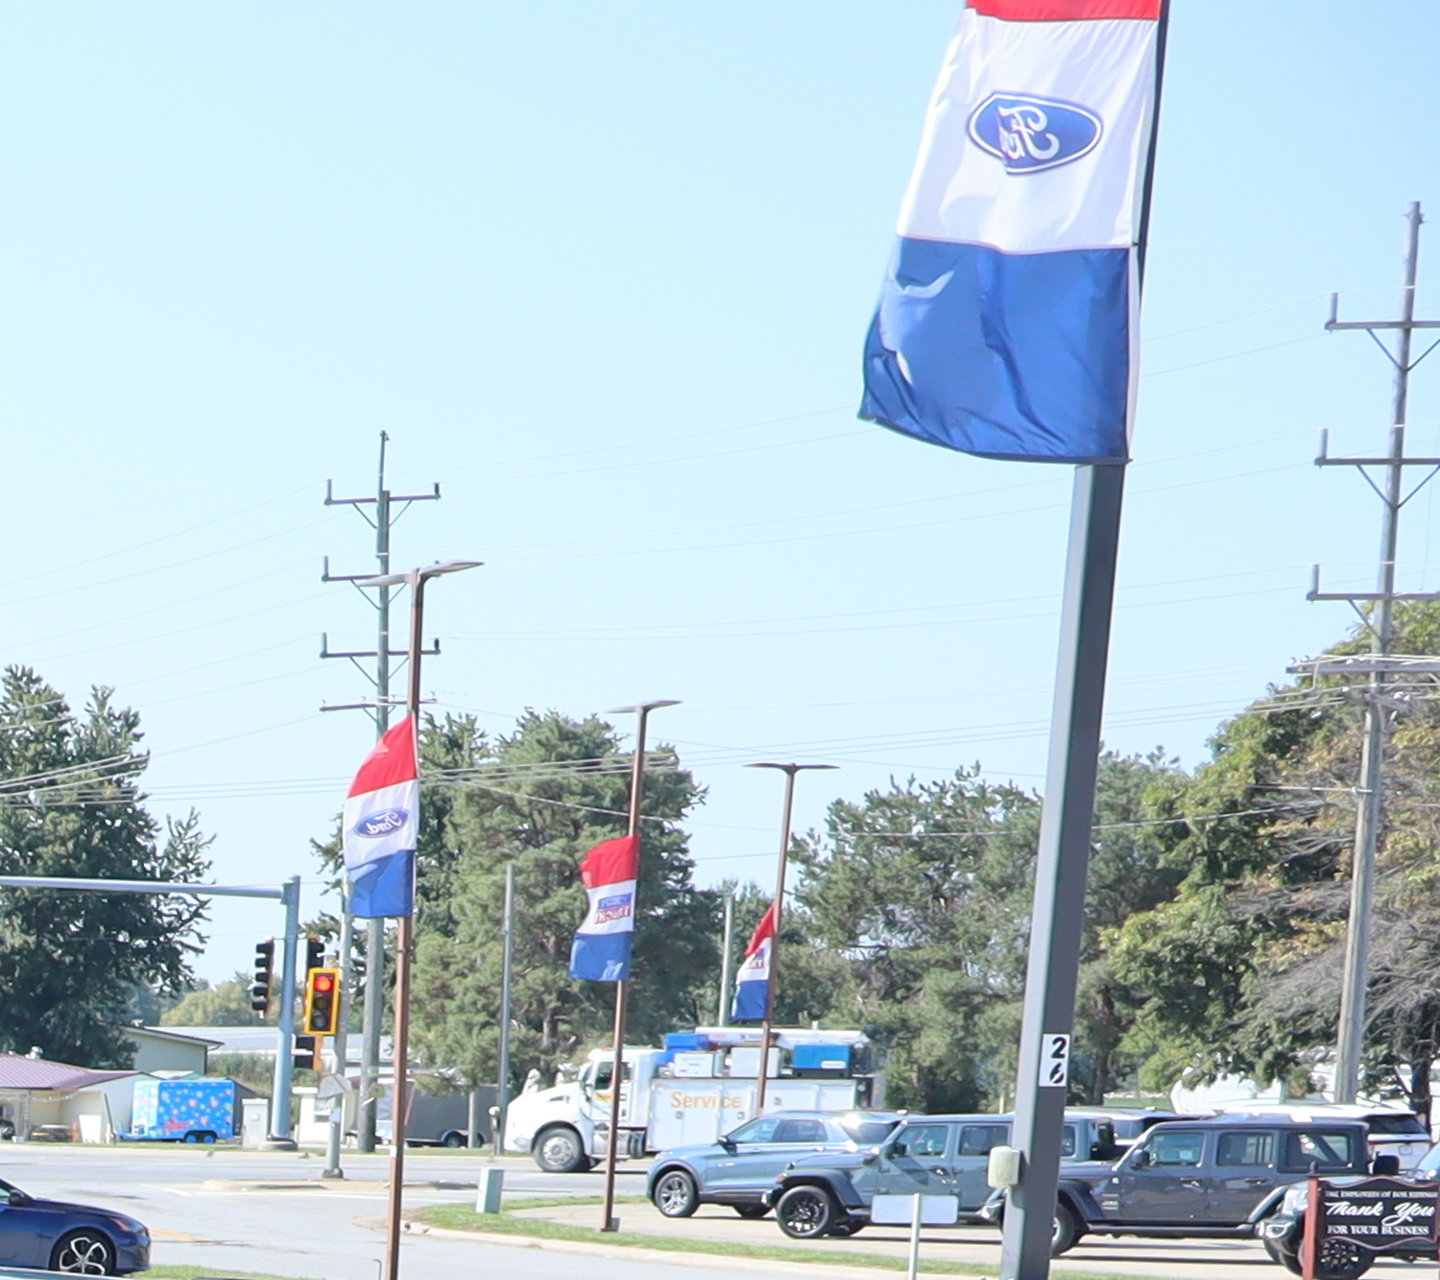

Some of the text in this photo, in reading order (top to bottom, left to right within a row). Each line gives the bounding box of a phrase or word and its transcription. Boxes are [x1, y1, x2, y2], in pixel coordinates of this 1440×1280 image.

[671, 1091, 741, 1109] Service
[1324, 1201, 1435, 1226] Thank You
[1327, 1225, 1430, 1235] FOR YOUR BUSINESS
